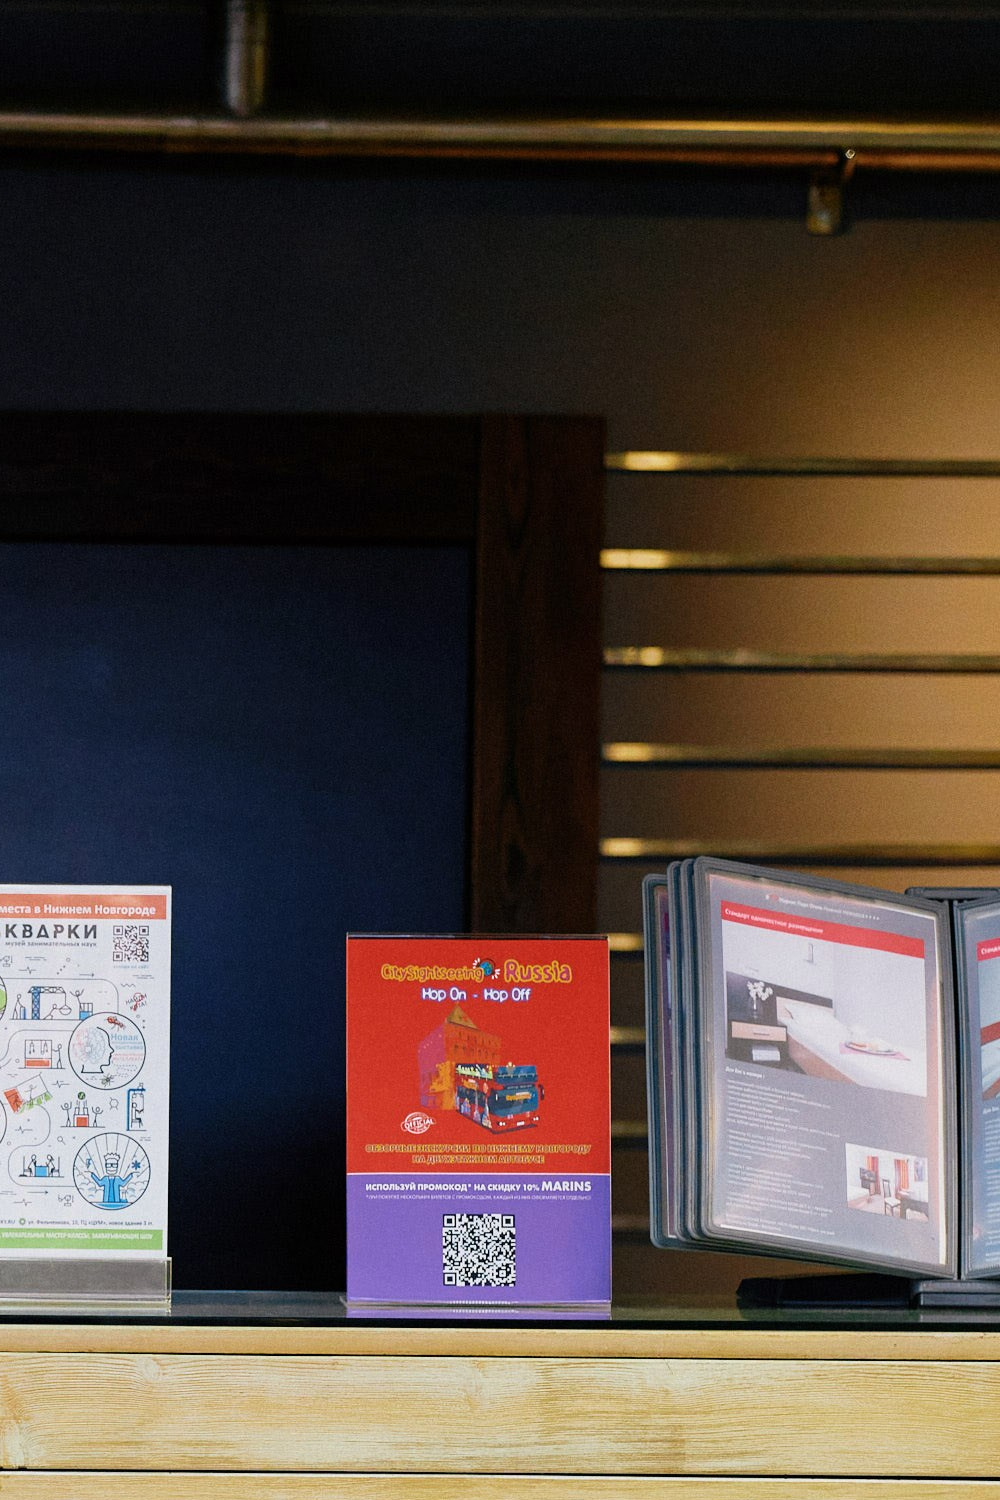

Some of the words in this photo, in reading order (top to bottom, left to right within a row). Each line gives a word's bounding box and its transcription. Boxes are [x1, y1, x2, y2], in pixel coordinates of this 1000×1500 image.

[34, 906, 40, 914] в
[44, 904, 92, 915] Нижнем
[95, 905, 156, 917] Новгороде
[5, 924, 97, 939] КВАРКИ
[381, 963, 484, 982] CitySightseeing
[504, 959, 572, 984] Russia
[421, 987, 447, 1002] Hop
[450, 987, 467, 1001] On
[483, 987, 508, 1003] Hop
[512, 988, 532, 1002] Off
[365, 1182, 416, 1191] ИСПОЛЬЗУЙ
[488, 1184, 520, 1192] СКИДКУ
[523, 1184, 540, 1192] 10%
[542, 1181, 592, 1192] MARINS
